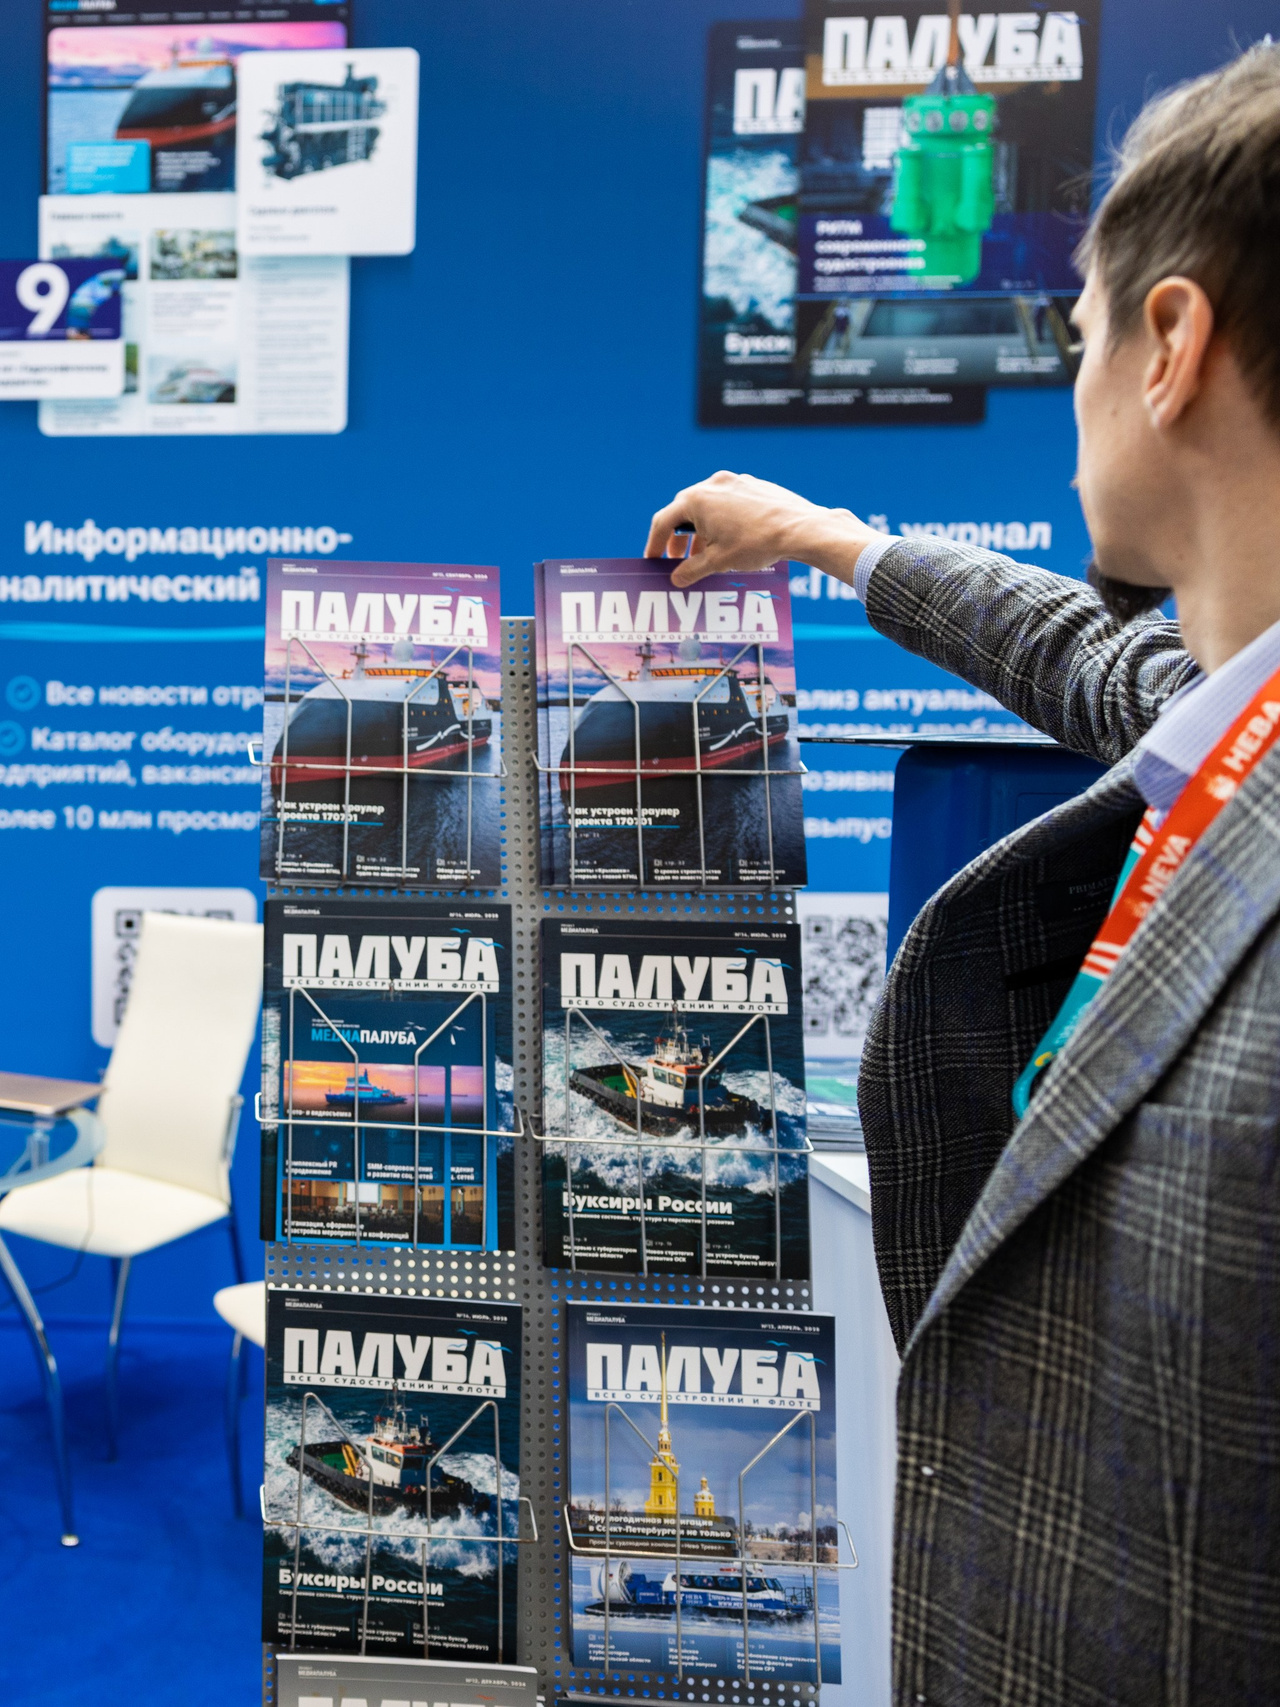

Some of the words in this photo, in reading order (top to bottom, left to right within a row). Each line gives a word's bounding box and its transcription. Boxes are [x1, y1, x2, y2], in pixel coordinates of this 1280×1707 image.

[823, 12, 1083, 68] ПАЛУБА
[16, 262, 70, 335] 9
[24, 519, 353, 563] Информационно-
[281, 590, 488, 637] ПАЛУБА
[561, 590, 779, 632] ПАЛУБА
[45, 680, 95, 707] Все
[99, 684, 208, 707] новости
[31, 726, 136, 753] Каталог
[63, 805, 93, 829] 10
[98, 807, 152, 829] млн
[298, 802, 340, 813] устроен
[590, 807, 633, 817] устроен
[283, 933, 499, 981] ПАЛУБА
[561, 953, 788, 1003] ПАЛУБА
[311, 1028, 417, 1046] МЕДИАПАЛУБА
[562, 1191, 652, 1214] Буксиры
[658, 1195, 733, 1214] России
[284, 1327, 506, 1387] ПАЛУБА
[586, 1342, 820, 1399] ПАЛУБА
[334, 1377, 434, 1390] СУДОСТРОЕНИИ
[457, 1385, 499, 1395] ФЛОТЕ
[640, 1394, 744, 1404] СУДОСТРОЕНИИ
[768, 1399, 812, 1408] ФЛОТЕ
[588, 1514, 662, 1524] Крулогодичная
[699, 1530, 732, 1538] только
[279, 1568, 366, 1593] Буксиры
[372, 1575, 443, 1596] России
